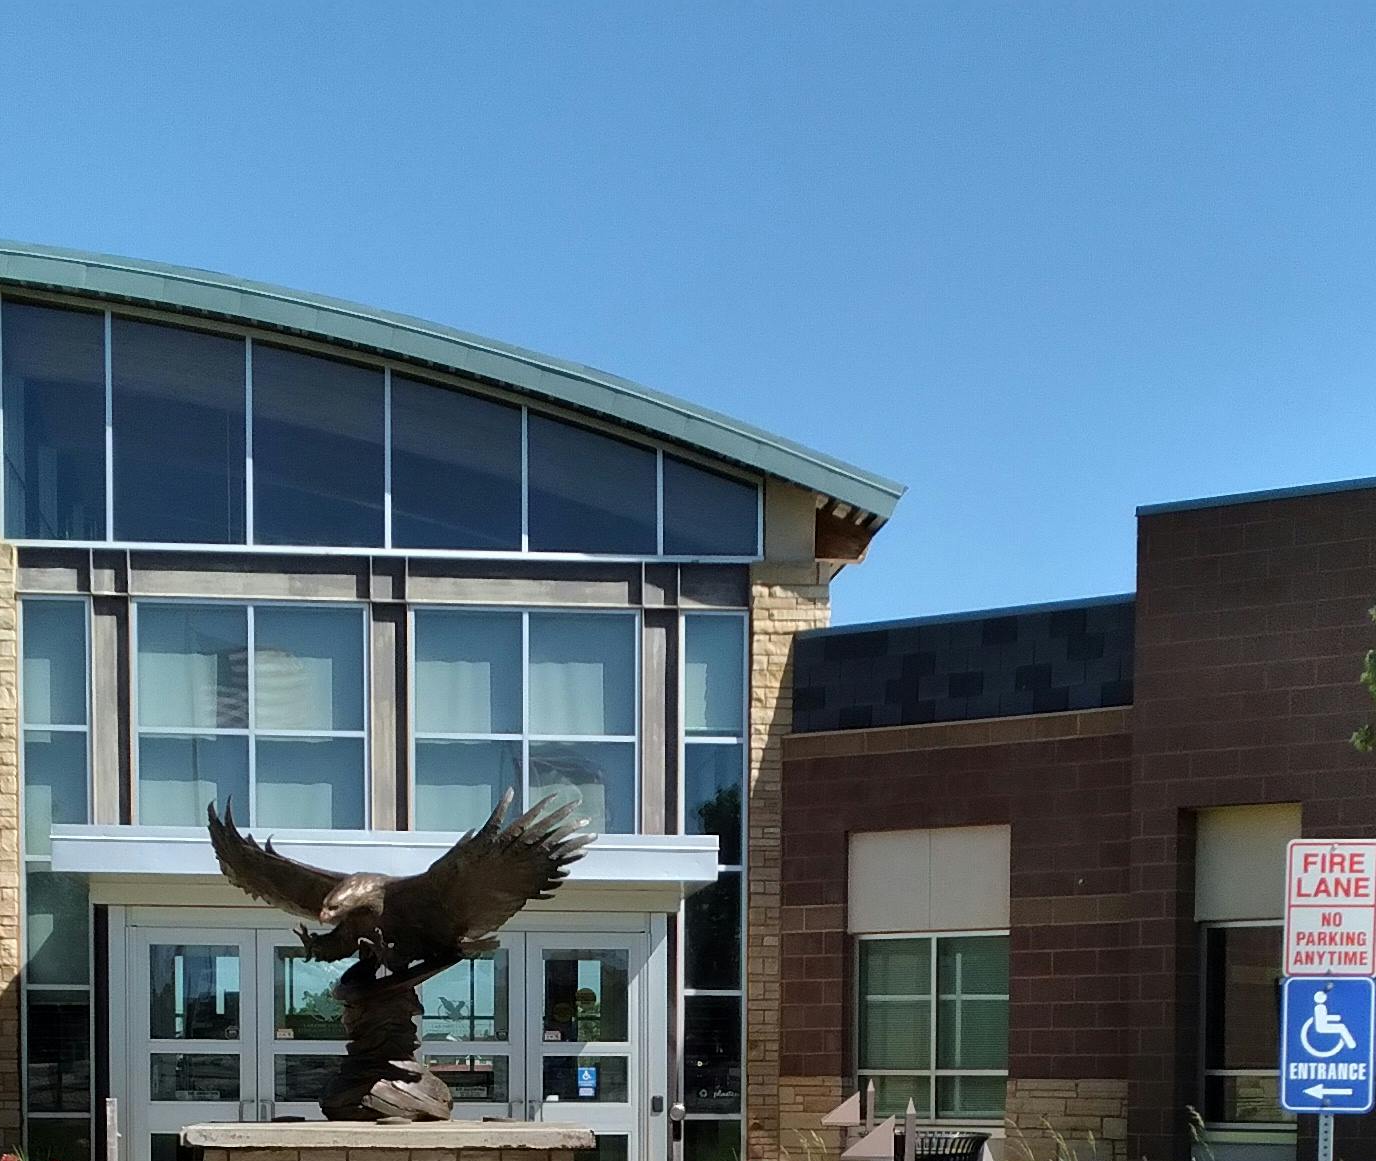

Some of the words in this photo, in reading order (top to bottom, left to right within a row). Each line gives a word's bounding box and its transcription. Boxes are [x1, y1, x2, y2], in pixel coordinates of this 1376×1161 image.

[1302, 853, 1366, 874] FIRE
[1295, 877, 1370, 898] LANE
[1321, 912, 1342, 927] NO
[1296, 931, 1367, 947] PARKING
[1293, 950, 1368, 966] ANYTIME
[1289, 1062, 1367, 1081] ENTRANCE
